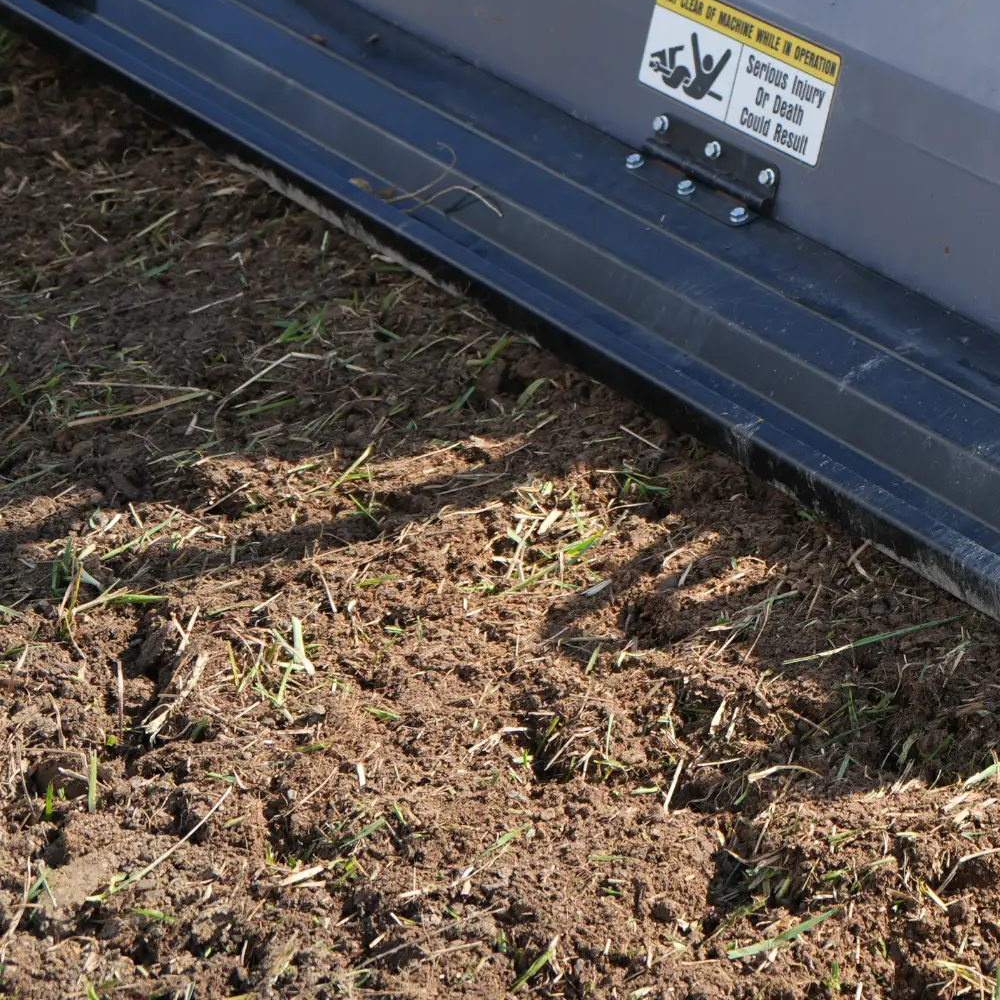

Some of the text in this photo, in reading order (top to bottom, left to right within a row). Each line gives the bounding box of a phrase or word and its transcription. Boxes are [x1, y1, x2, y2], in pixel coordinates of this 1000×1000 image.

[705, 3, 716, 20] OF
[718, 11, 754, 39] MACHINE
[756, 27, 781, 51] WHILE
[783, 39, 793, 56] IN
[794, 45, 837, 77] OPERATION
[746, 54, 826, 109] Serious Injury
[755, 87, 804, 126] Or Death
[740, 107, 808, 156] Could Result
